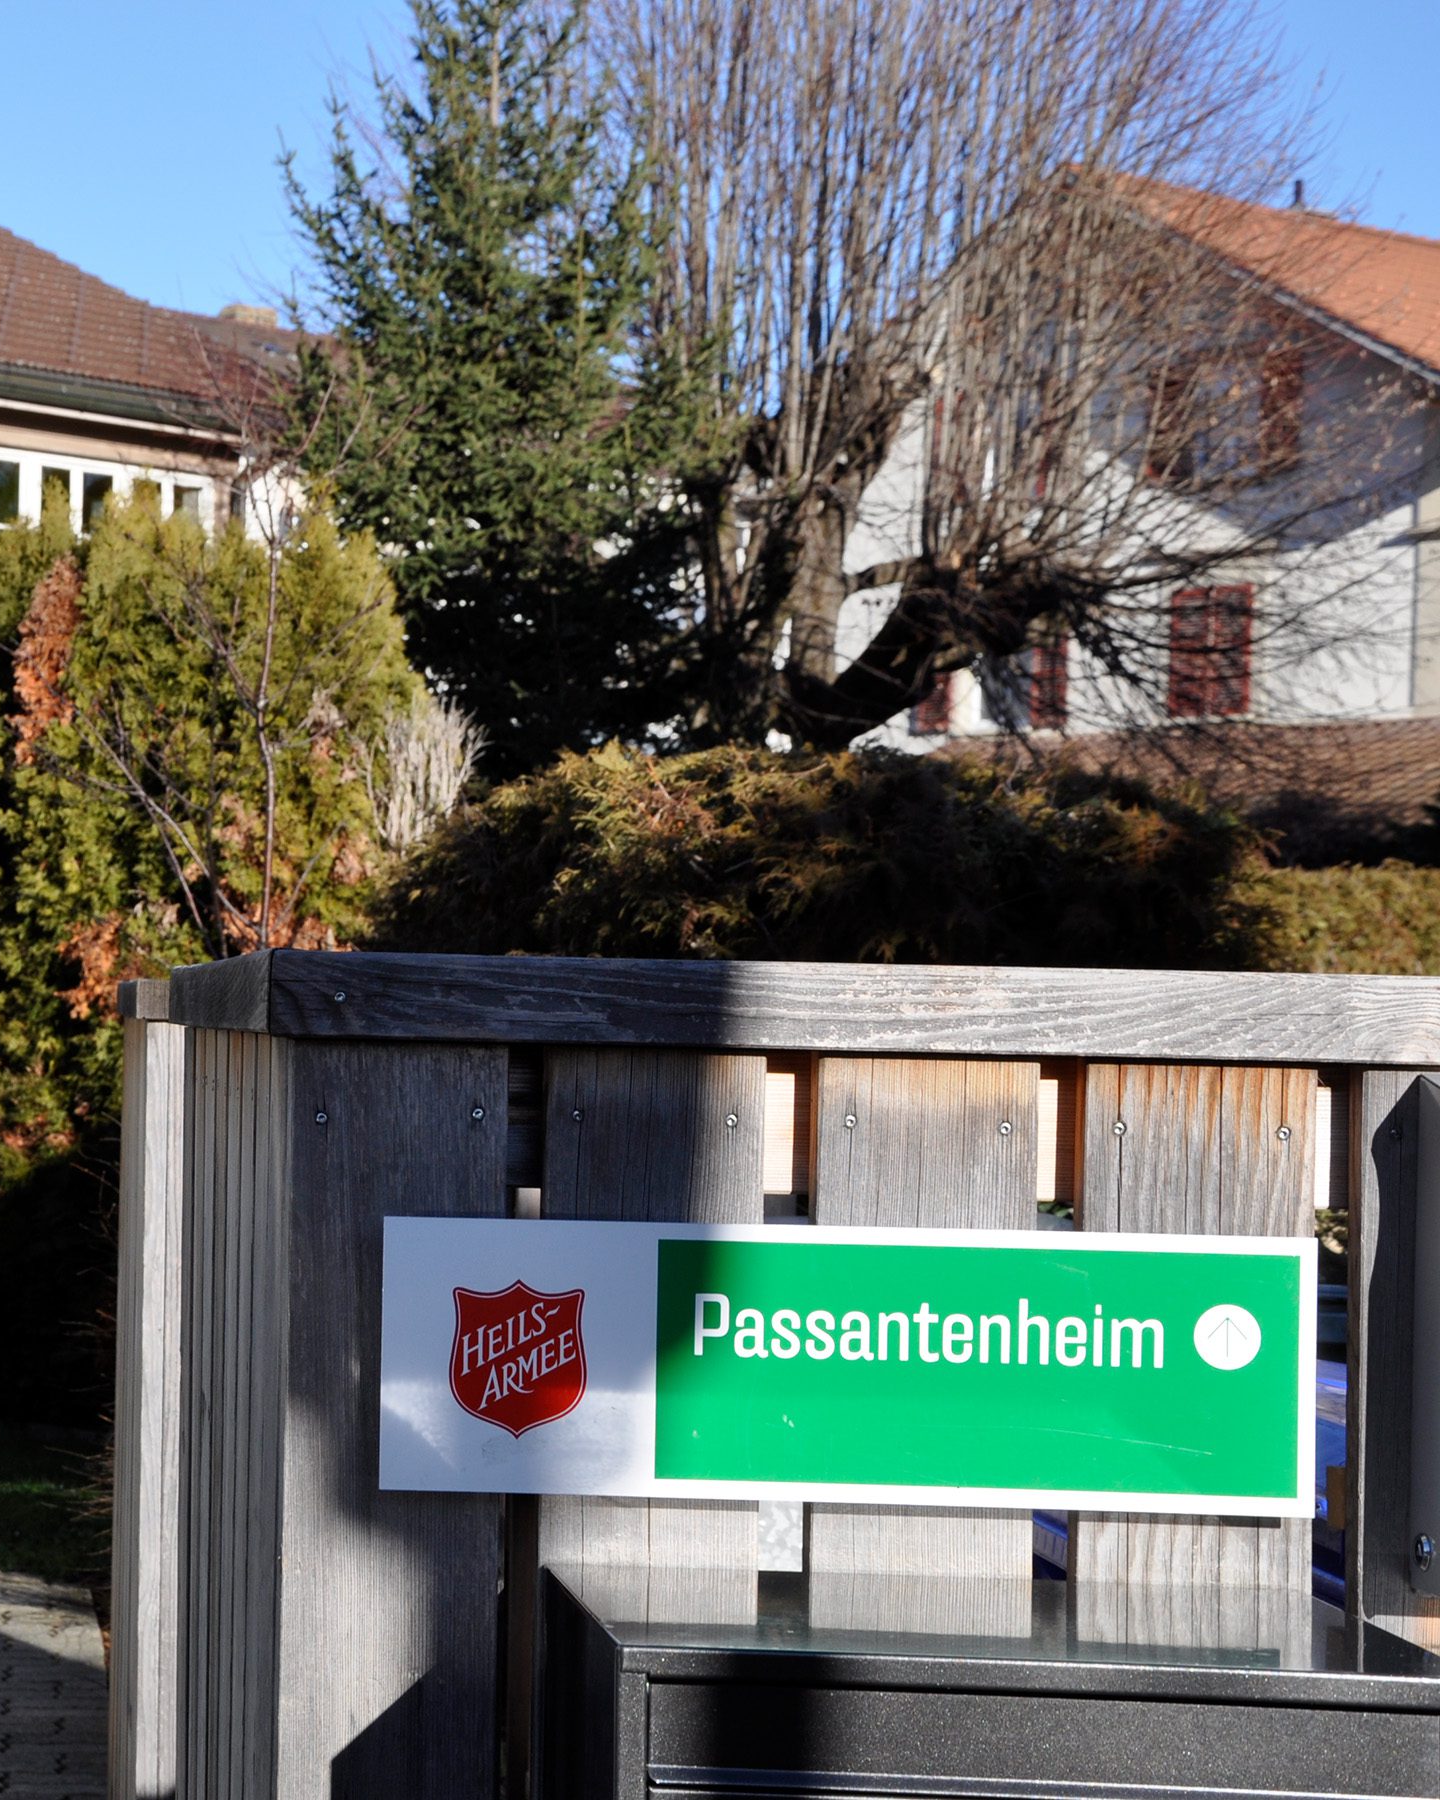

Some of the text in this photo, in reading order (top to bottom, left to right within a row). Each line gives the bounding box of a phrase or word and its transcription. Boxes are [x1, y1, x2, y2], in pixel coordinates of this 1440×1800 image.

[461, 1302, 561, 1377] HEILS-
[693, 1292, 1164, 1369] Passantenheim
[477, 1328, 576, 1411] ARMEE
